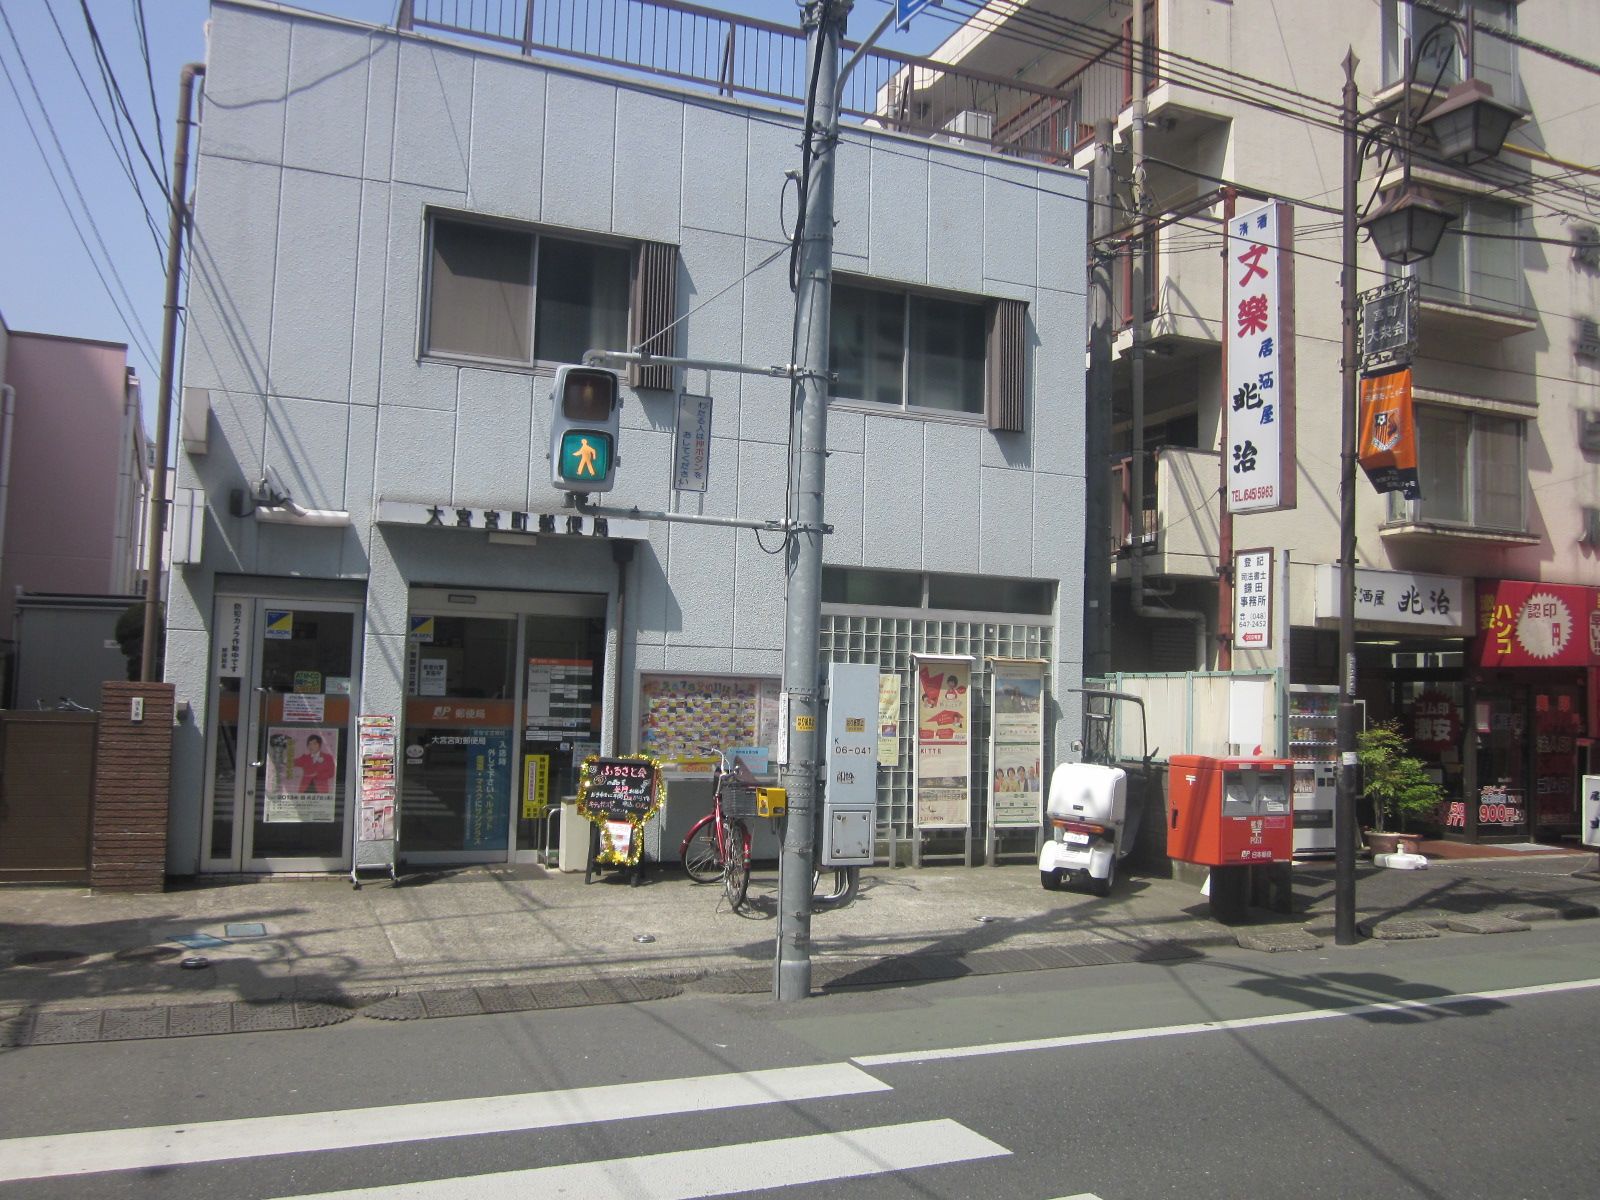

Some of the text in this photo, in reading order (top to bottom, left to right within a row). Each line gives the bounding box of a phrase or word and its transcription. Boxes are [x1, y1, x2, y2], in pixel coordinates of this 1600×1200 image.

[1258, 337, 1274, 425] 居酒屋
[426, 504, 609, 538] 大宮宮町郵便局
[1244, 556, 1264, 568] 登記
[1241, 571, 1267, 581] 司法書士
[1240, 595, 1266, 608] 事務所
[1353, 588, 1385, 607] 酒屋
[1527, 603, 1557, 619] 認印
[1495, 604, 1513, 654] ハンコ
[431, 736, 487, 745] 大宮宮町郵便局
[835, 746, 872, 755] 06-041
[601, 765, 647, 779] ふるさと会
